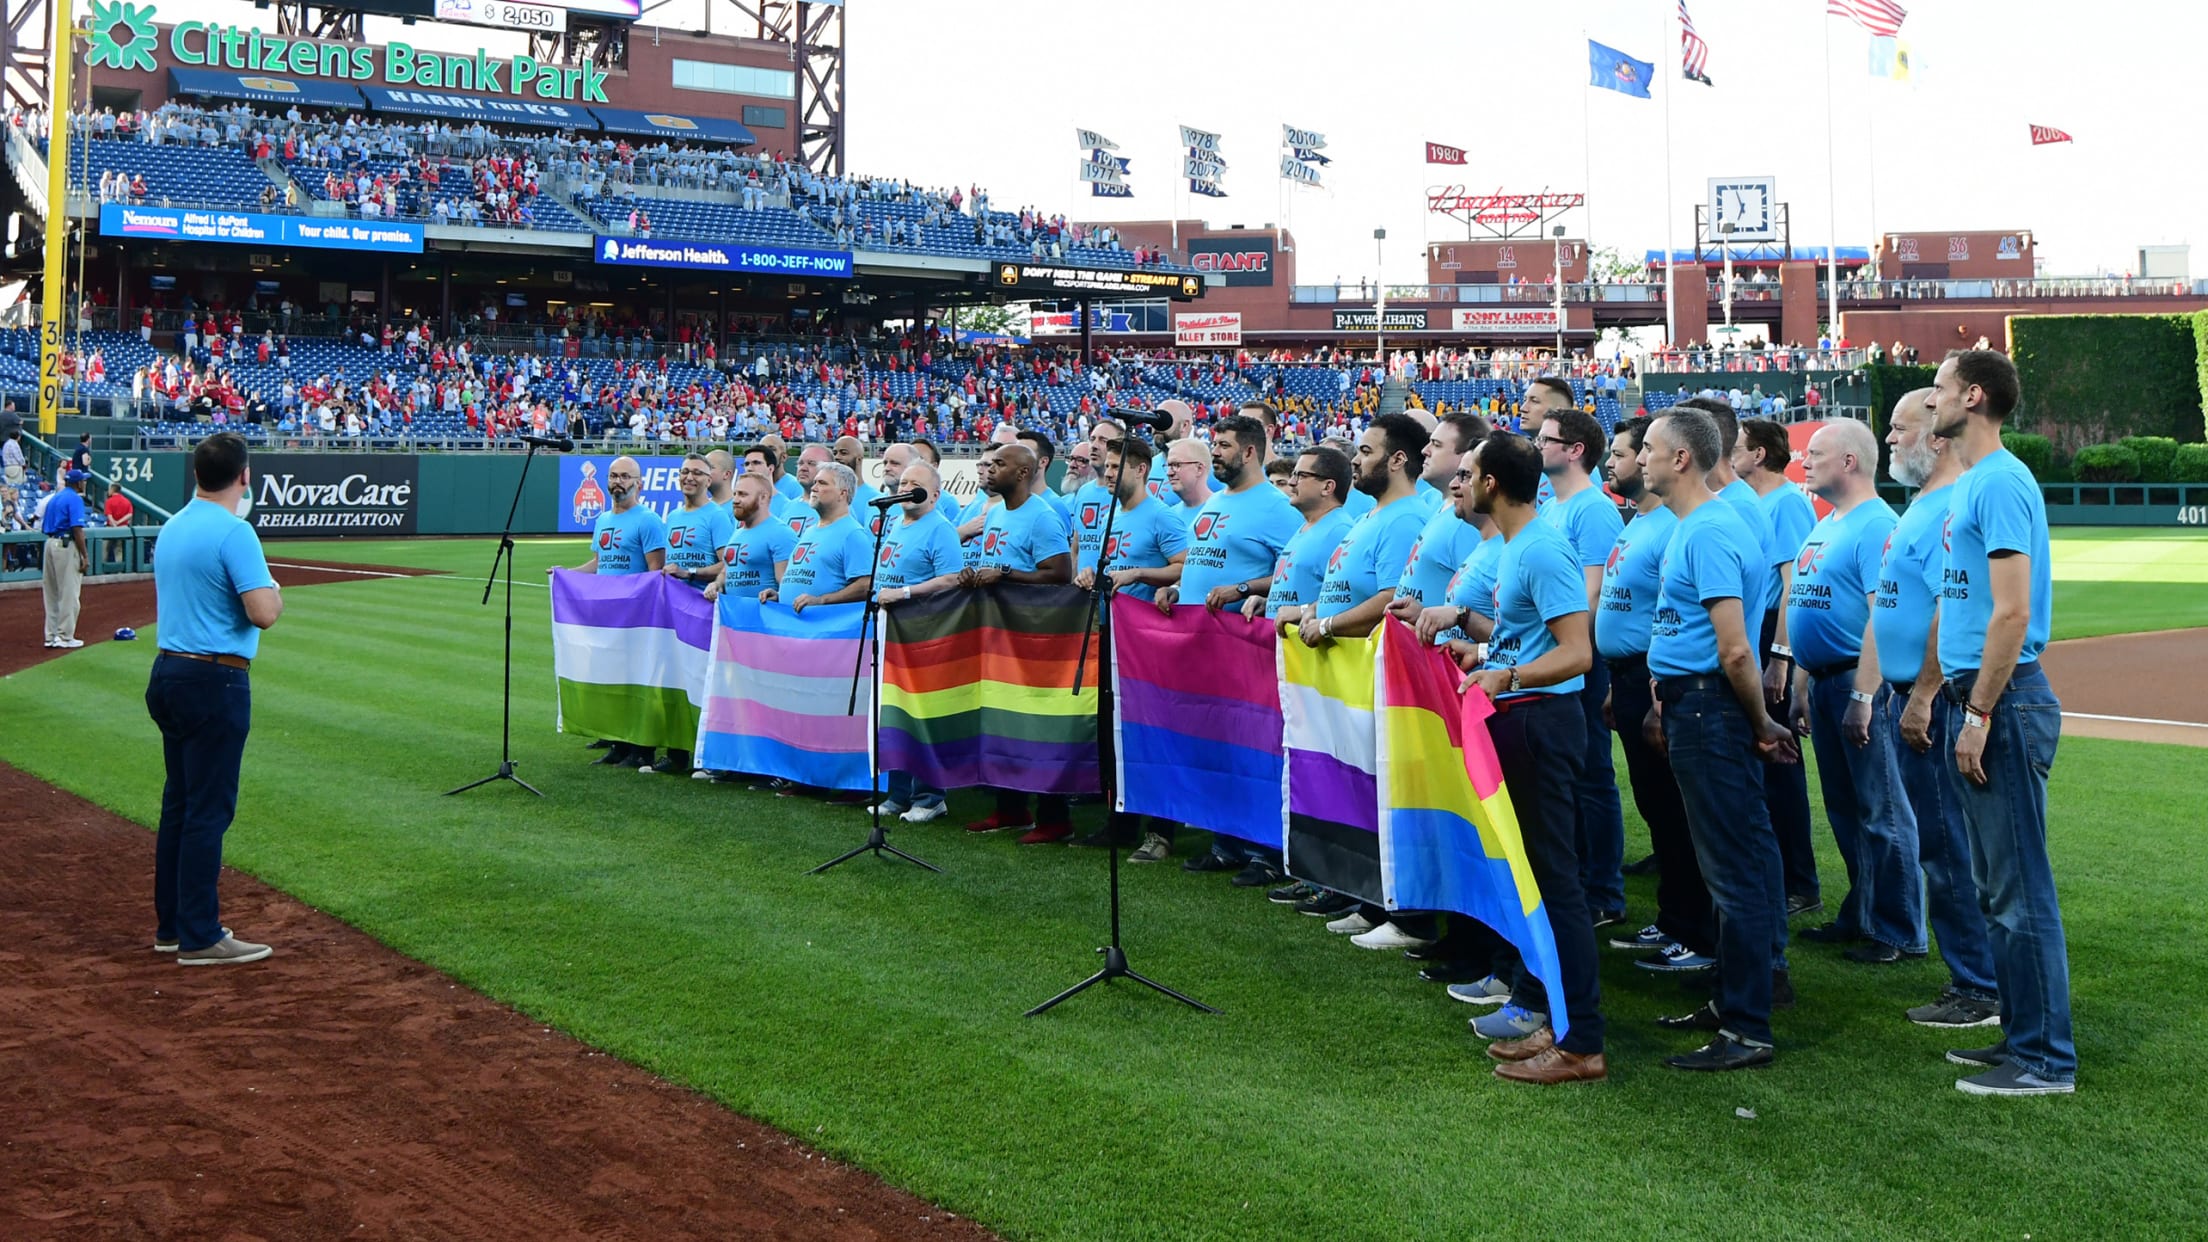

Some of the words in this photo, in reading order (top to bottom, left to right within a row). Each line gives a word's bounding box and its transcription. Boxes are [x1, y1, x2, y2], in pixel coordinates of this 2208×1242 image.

[503, 6, 553, 26] 2,050
[171, 20, 374, 80] Citizens
[385, 41, 503, 92] Bank
[510, 54, 609, 103] Park
[386, 90, 485, 110] HARRY
[487, 101, 528, 112] THE
[524, 103, 571, 118] K'S
[1186, 129, 1213, 149] 1978
[1288, 129, 1316, 146] 2010
[1431, 145, 1459, 162] 1980
[1085, 163, 1114, 181] 1977
[1286, 160, 1315, 181] 2011
[1425, 184, 1584, 214] Budweiser
[122, 210, 178, 227] Nemours
[183, 213, 209, 225] Alfred
[182, 224, 217, 237] Hospital
[217, 225, 230, 236] for
[231, 226, 264, 239] Children
[298, 224, 323, 238] Your
[323, 224, 350, 240] child.
[352, 226, 370, 241] Our
[371, 227, 413, 244] promise.
[621, 243, 683, 263] Jefferson
[683, 248, 729, 265] Health.
[1499, 246, 1514, 262] 14
[1900, 239, 1918, 254] 32
[1949, 237, 1968, 254] 36
[1999, 236, 2017, 254] 42
[740, 252, 846, 271] 1-800-JEFF-NOW
[1191, 251, 1268, 272] GIANT
[1447, 248, 1455, 262] 1
[1022, 267, 1053, 278] DON'T
[1053, 269, 1076, 280] MISS
[1076, 271, 1095, 281] THE
[1096, 272, 1123, 283] GAME
[1130, 274, 1166, 286] STREAM
[1463, 312, 1503, 321] TONY
[1505, 312, 1557, 321] LUKE'S
[1177, 332, 1205, 342] ALLEY
[1210, 332, 1239, 341] STORE
[109, 457, 153, 482] 334
[255, 474, 410, 506] NovaCare
[257, 513, 404, 527] REHABILITATION
[2177, 506, 2207, 524] 401
[1196, 558, 1225, 569] CHORUS
[1797, 598, 1831, 610] CHORUS
